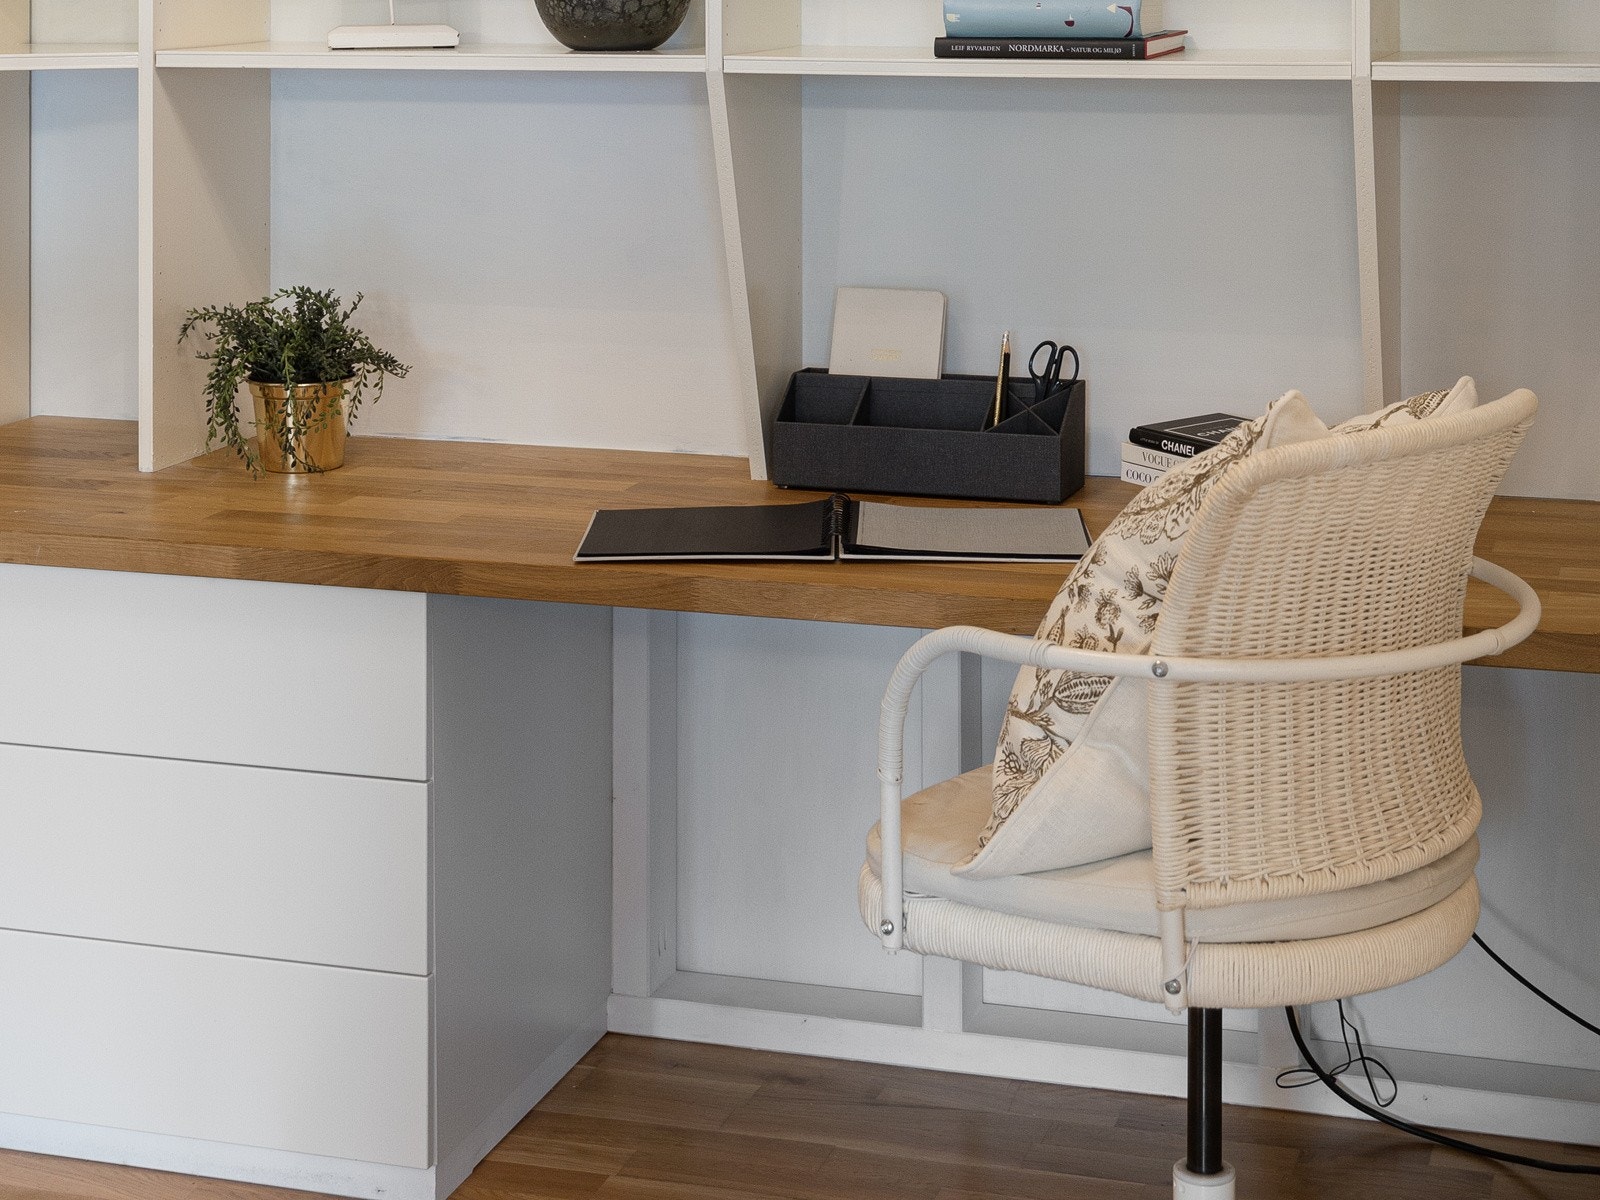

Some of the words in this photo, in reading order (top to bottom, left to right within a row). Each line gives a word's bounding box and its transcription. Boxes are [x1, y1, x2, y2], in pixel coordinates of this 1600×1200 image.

[1008, 44, 1065, 53] NORDMARKA
[1142, 451, 1172, 468] VOGUE
[1125, 469, 1152, 484] COCO
